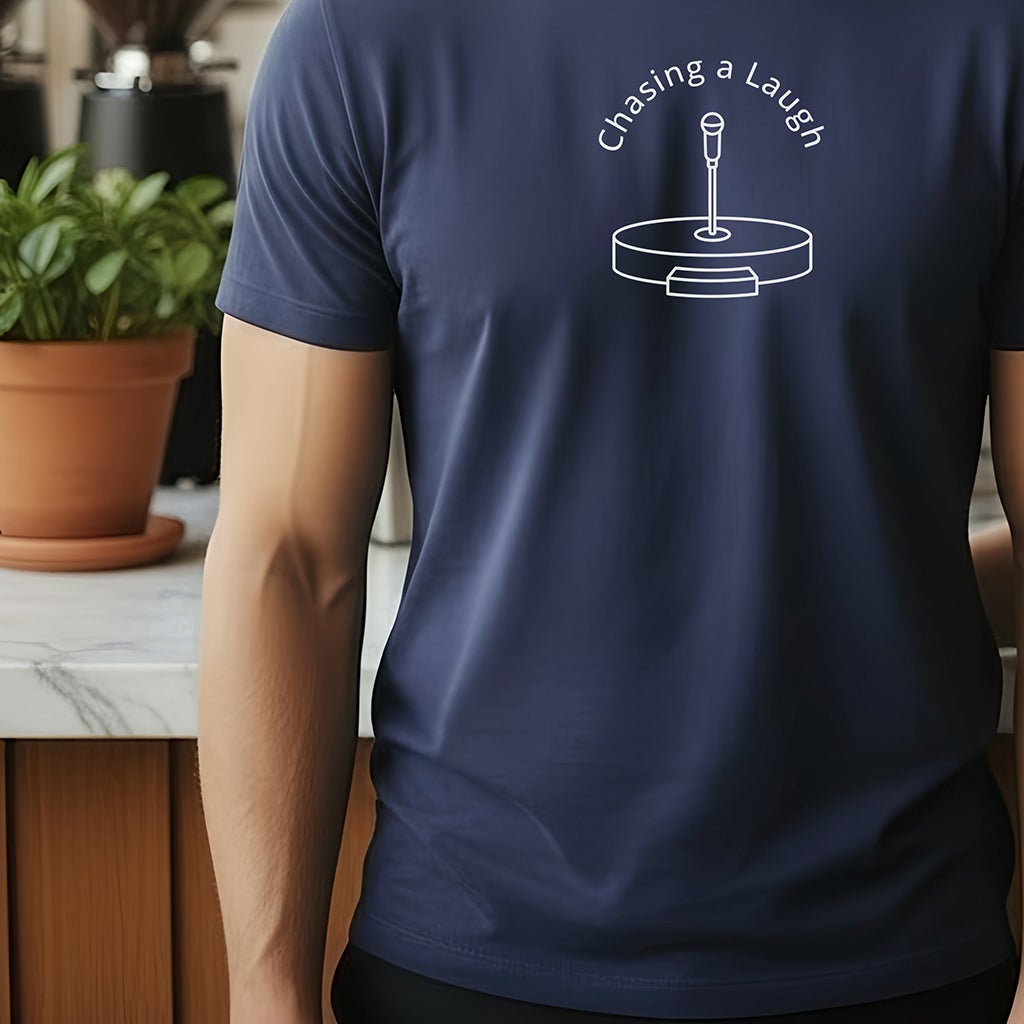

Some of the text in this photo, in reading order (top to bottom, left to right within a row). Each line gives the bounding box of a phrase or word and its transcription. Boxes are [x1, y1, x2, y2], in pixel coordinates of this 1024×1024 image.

[598, 59, 825, 152] Chasing a Laugh
